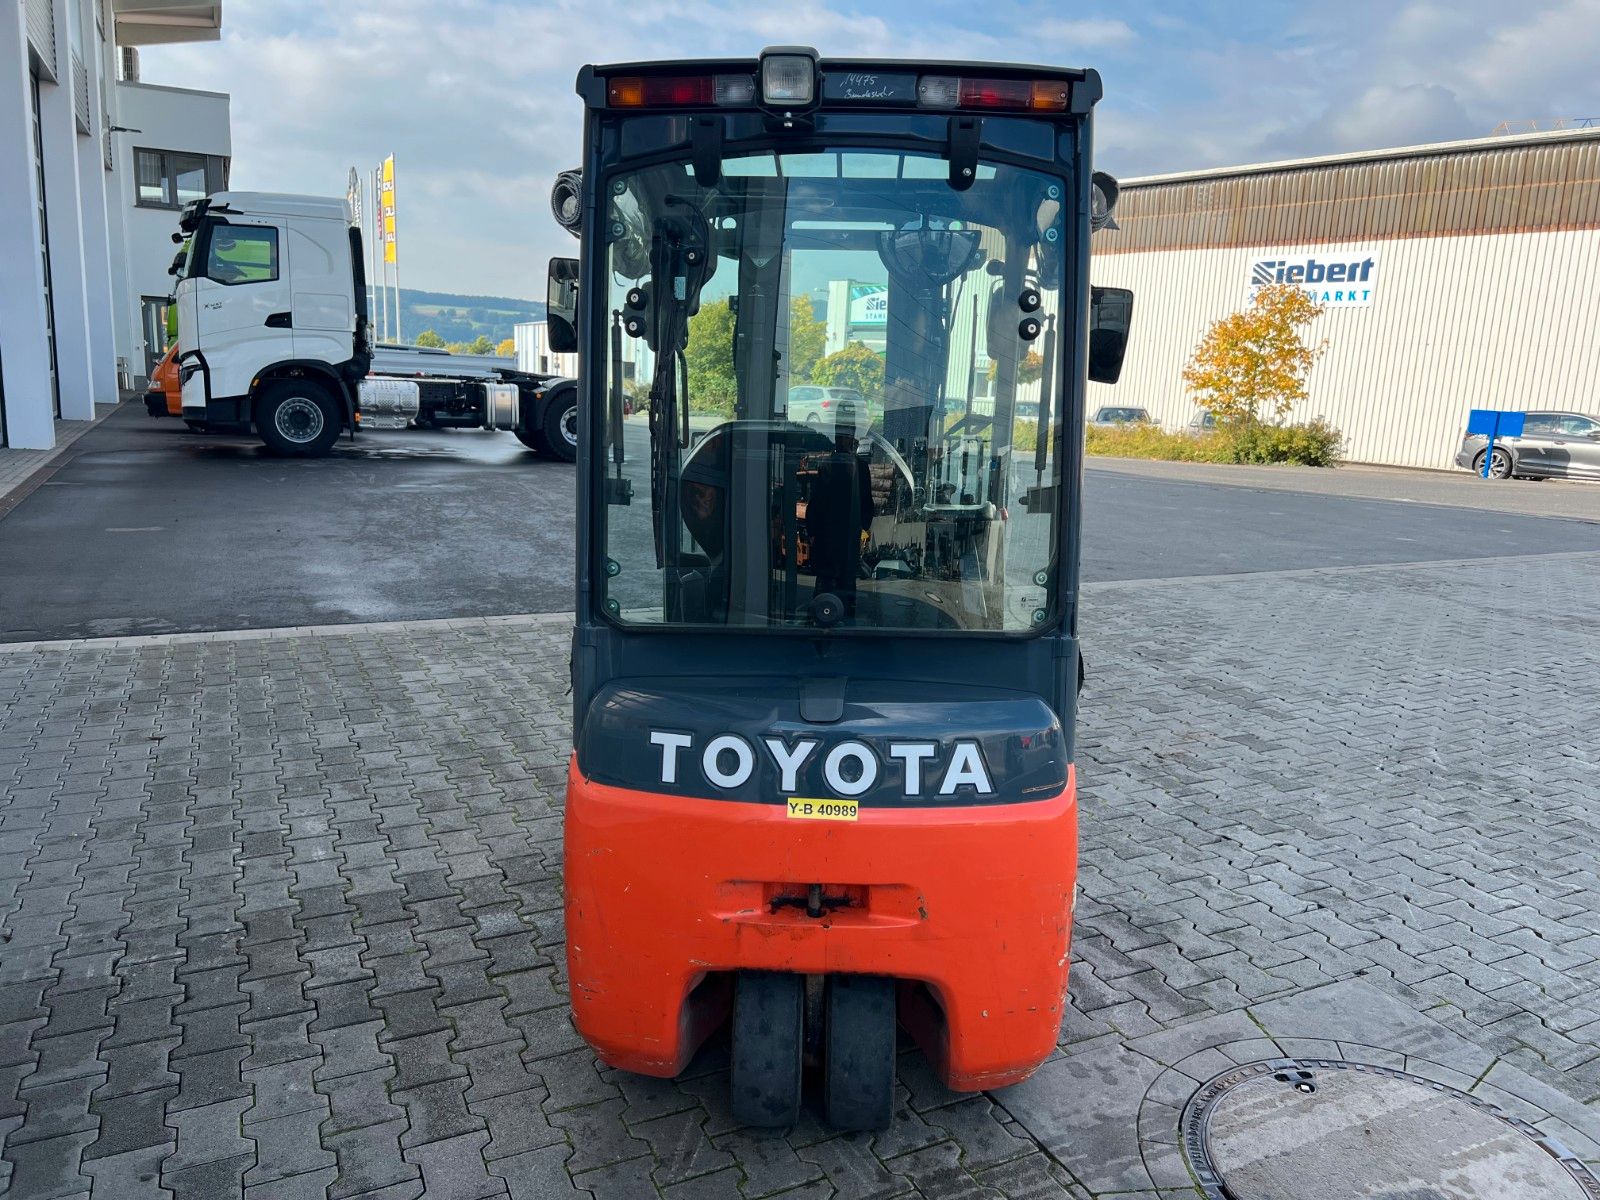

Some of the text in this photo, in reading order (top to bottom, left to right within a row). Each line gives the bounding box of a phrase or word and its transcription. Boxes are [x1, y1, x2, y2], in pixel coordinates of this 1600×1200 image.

[1251, 257, 1375, 285] Siebert
[650, 731, 992, 796] TOYOTA
[789, 802, 857, 817] Y-B 40989
